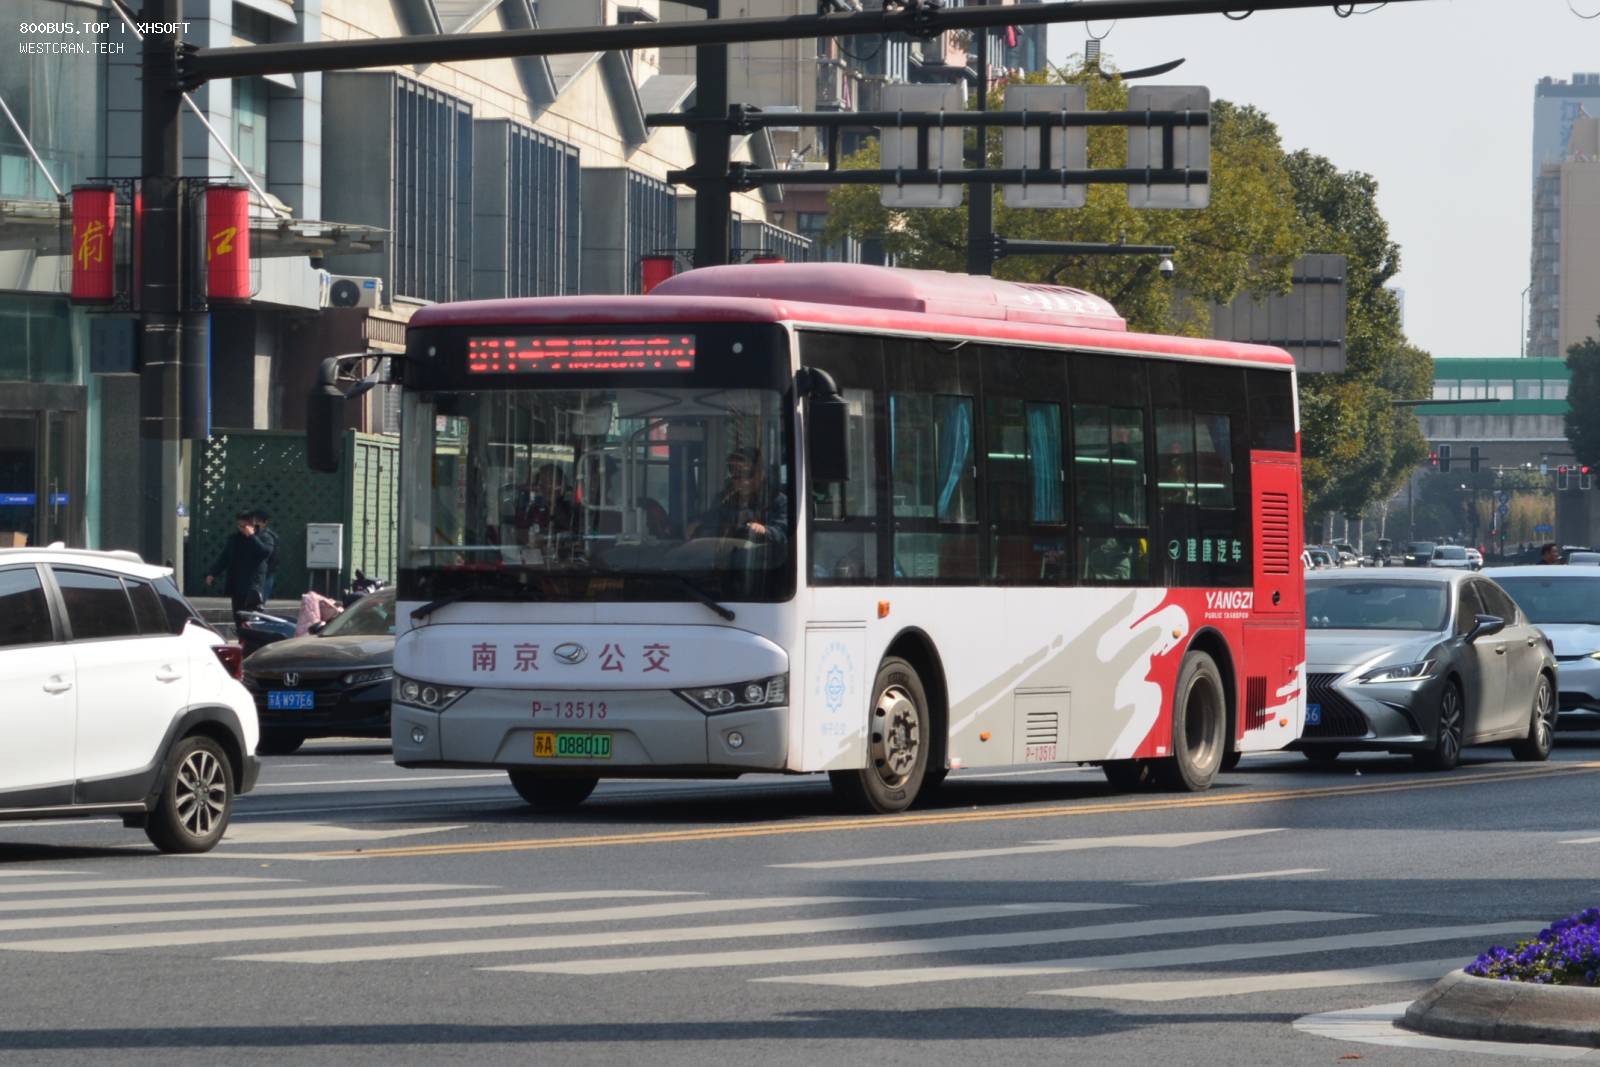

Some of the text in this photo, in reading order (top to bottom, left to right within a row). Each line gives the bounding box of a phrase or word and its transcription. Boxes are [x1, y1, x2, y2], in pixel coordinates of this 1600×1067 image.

[1205, 591, 1254, 609] YANGZI
[471, 642, 671, 673] 南京 公交
[532, 701, 608, 719] P-13513
